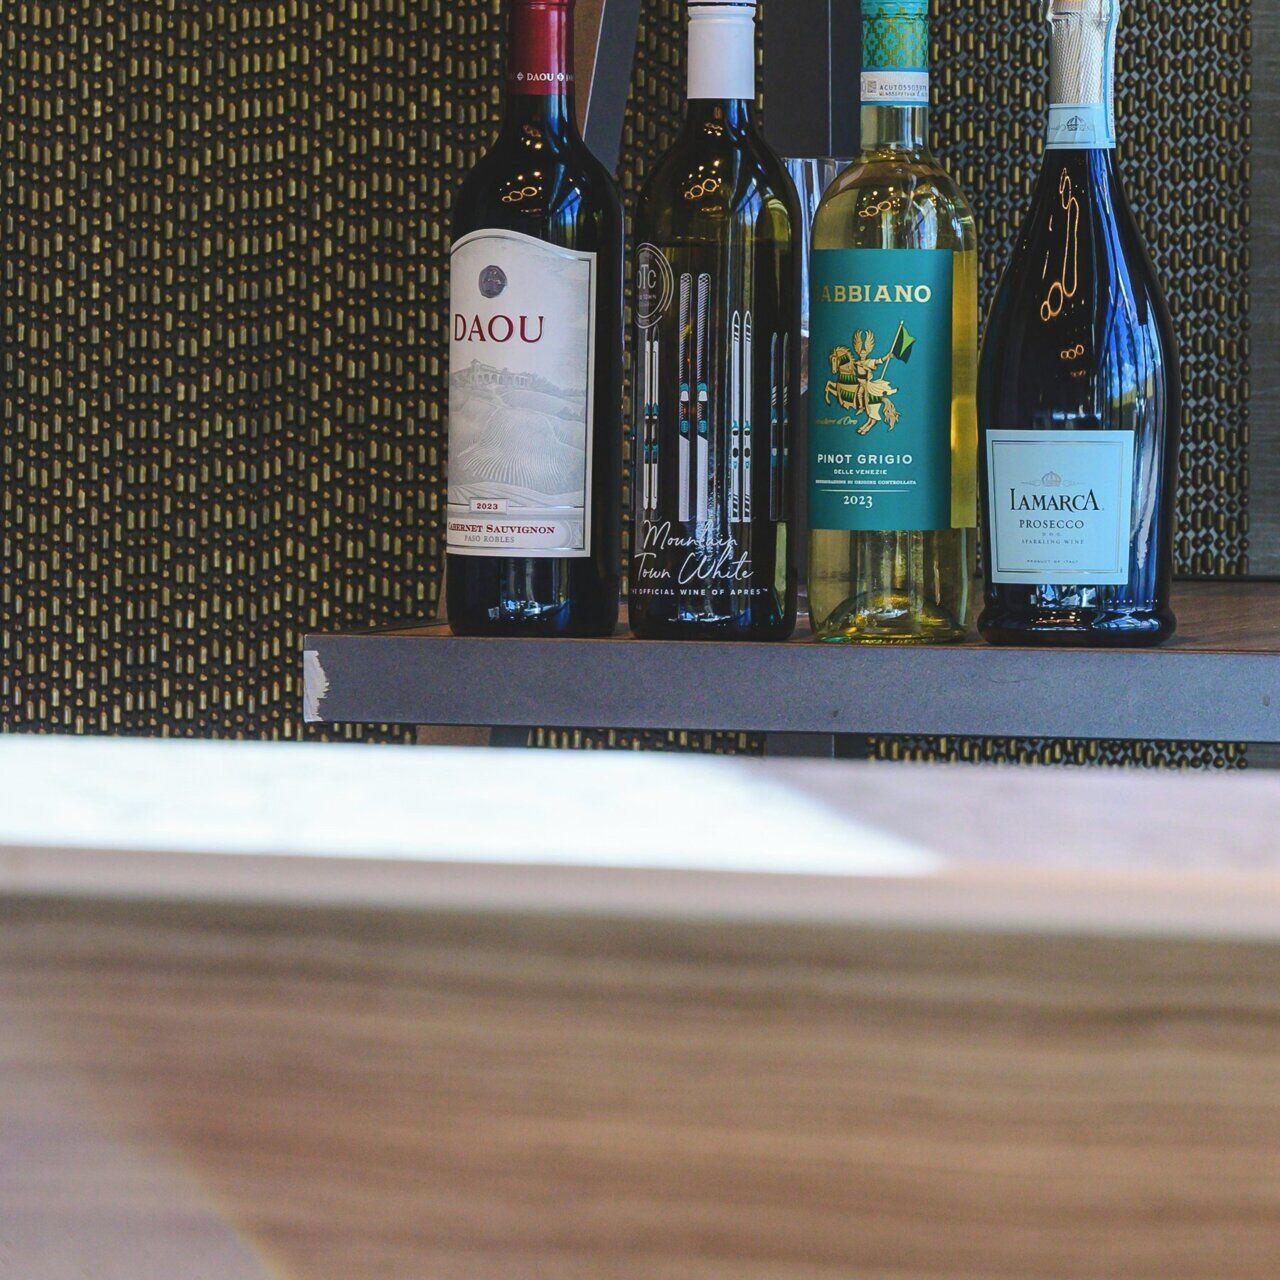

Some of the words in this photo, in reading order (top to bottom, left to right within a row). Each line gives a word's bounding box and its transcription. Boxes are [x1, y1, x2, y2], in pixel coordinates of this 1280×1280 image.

[527, 73, 554, 81] DAOU
[820, 285, 931, 303] ABBIANO
[454, 314, 544, 343] DAOU
[817, 454, 852, 464] PINOT
[857, 454, 912, 464] GRIGIO
[476, 502, 498, 510] 2023
[843, 495, 873, 508] 2023
[1020, 520, 1084, 528] PROSECCO
[464, 535, 481, 543] PASO
[644, 520, 738, 549] Mountain
[635, 552, 671, 581] Town
[678, 545, 753, 584] White
